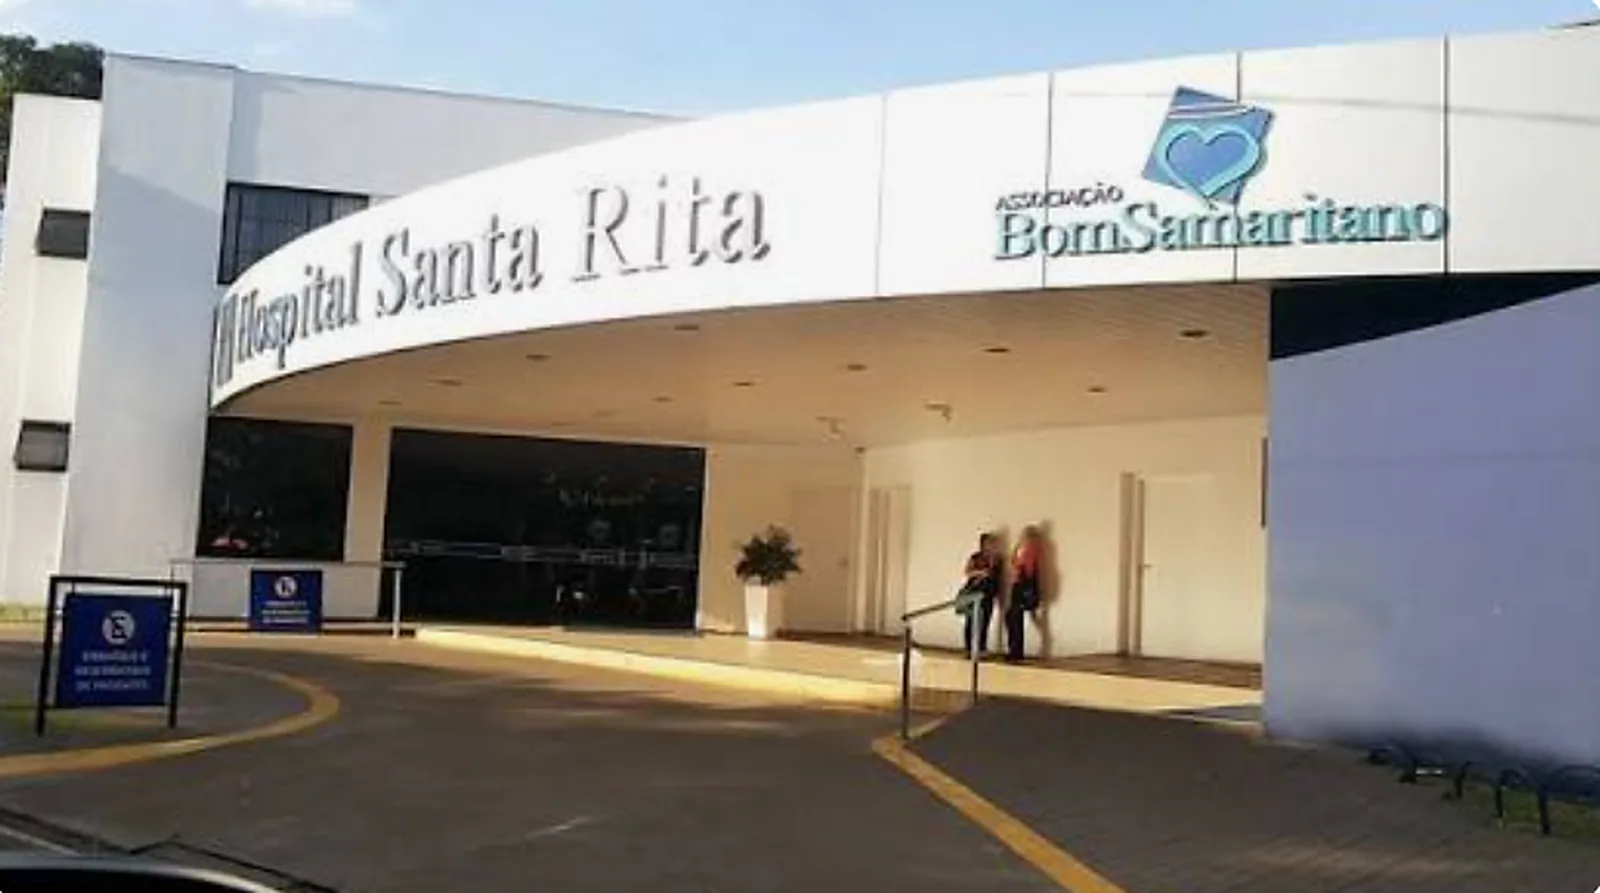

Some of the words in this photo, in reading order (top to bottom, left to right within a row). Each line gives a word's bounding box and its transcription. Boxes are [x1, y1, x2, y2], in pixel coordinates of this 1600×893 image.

[994, 194, 1448, 262] BomSamaritano
[995, 181, 1125, 211] ASSOCIAÇÃO
[236, 242, 364, 369] Hospital
[375, 213, 544, 318] Santa
[570, 173, 772, 283] Rita
